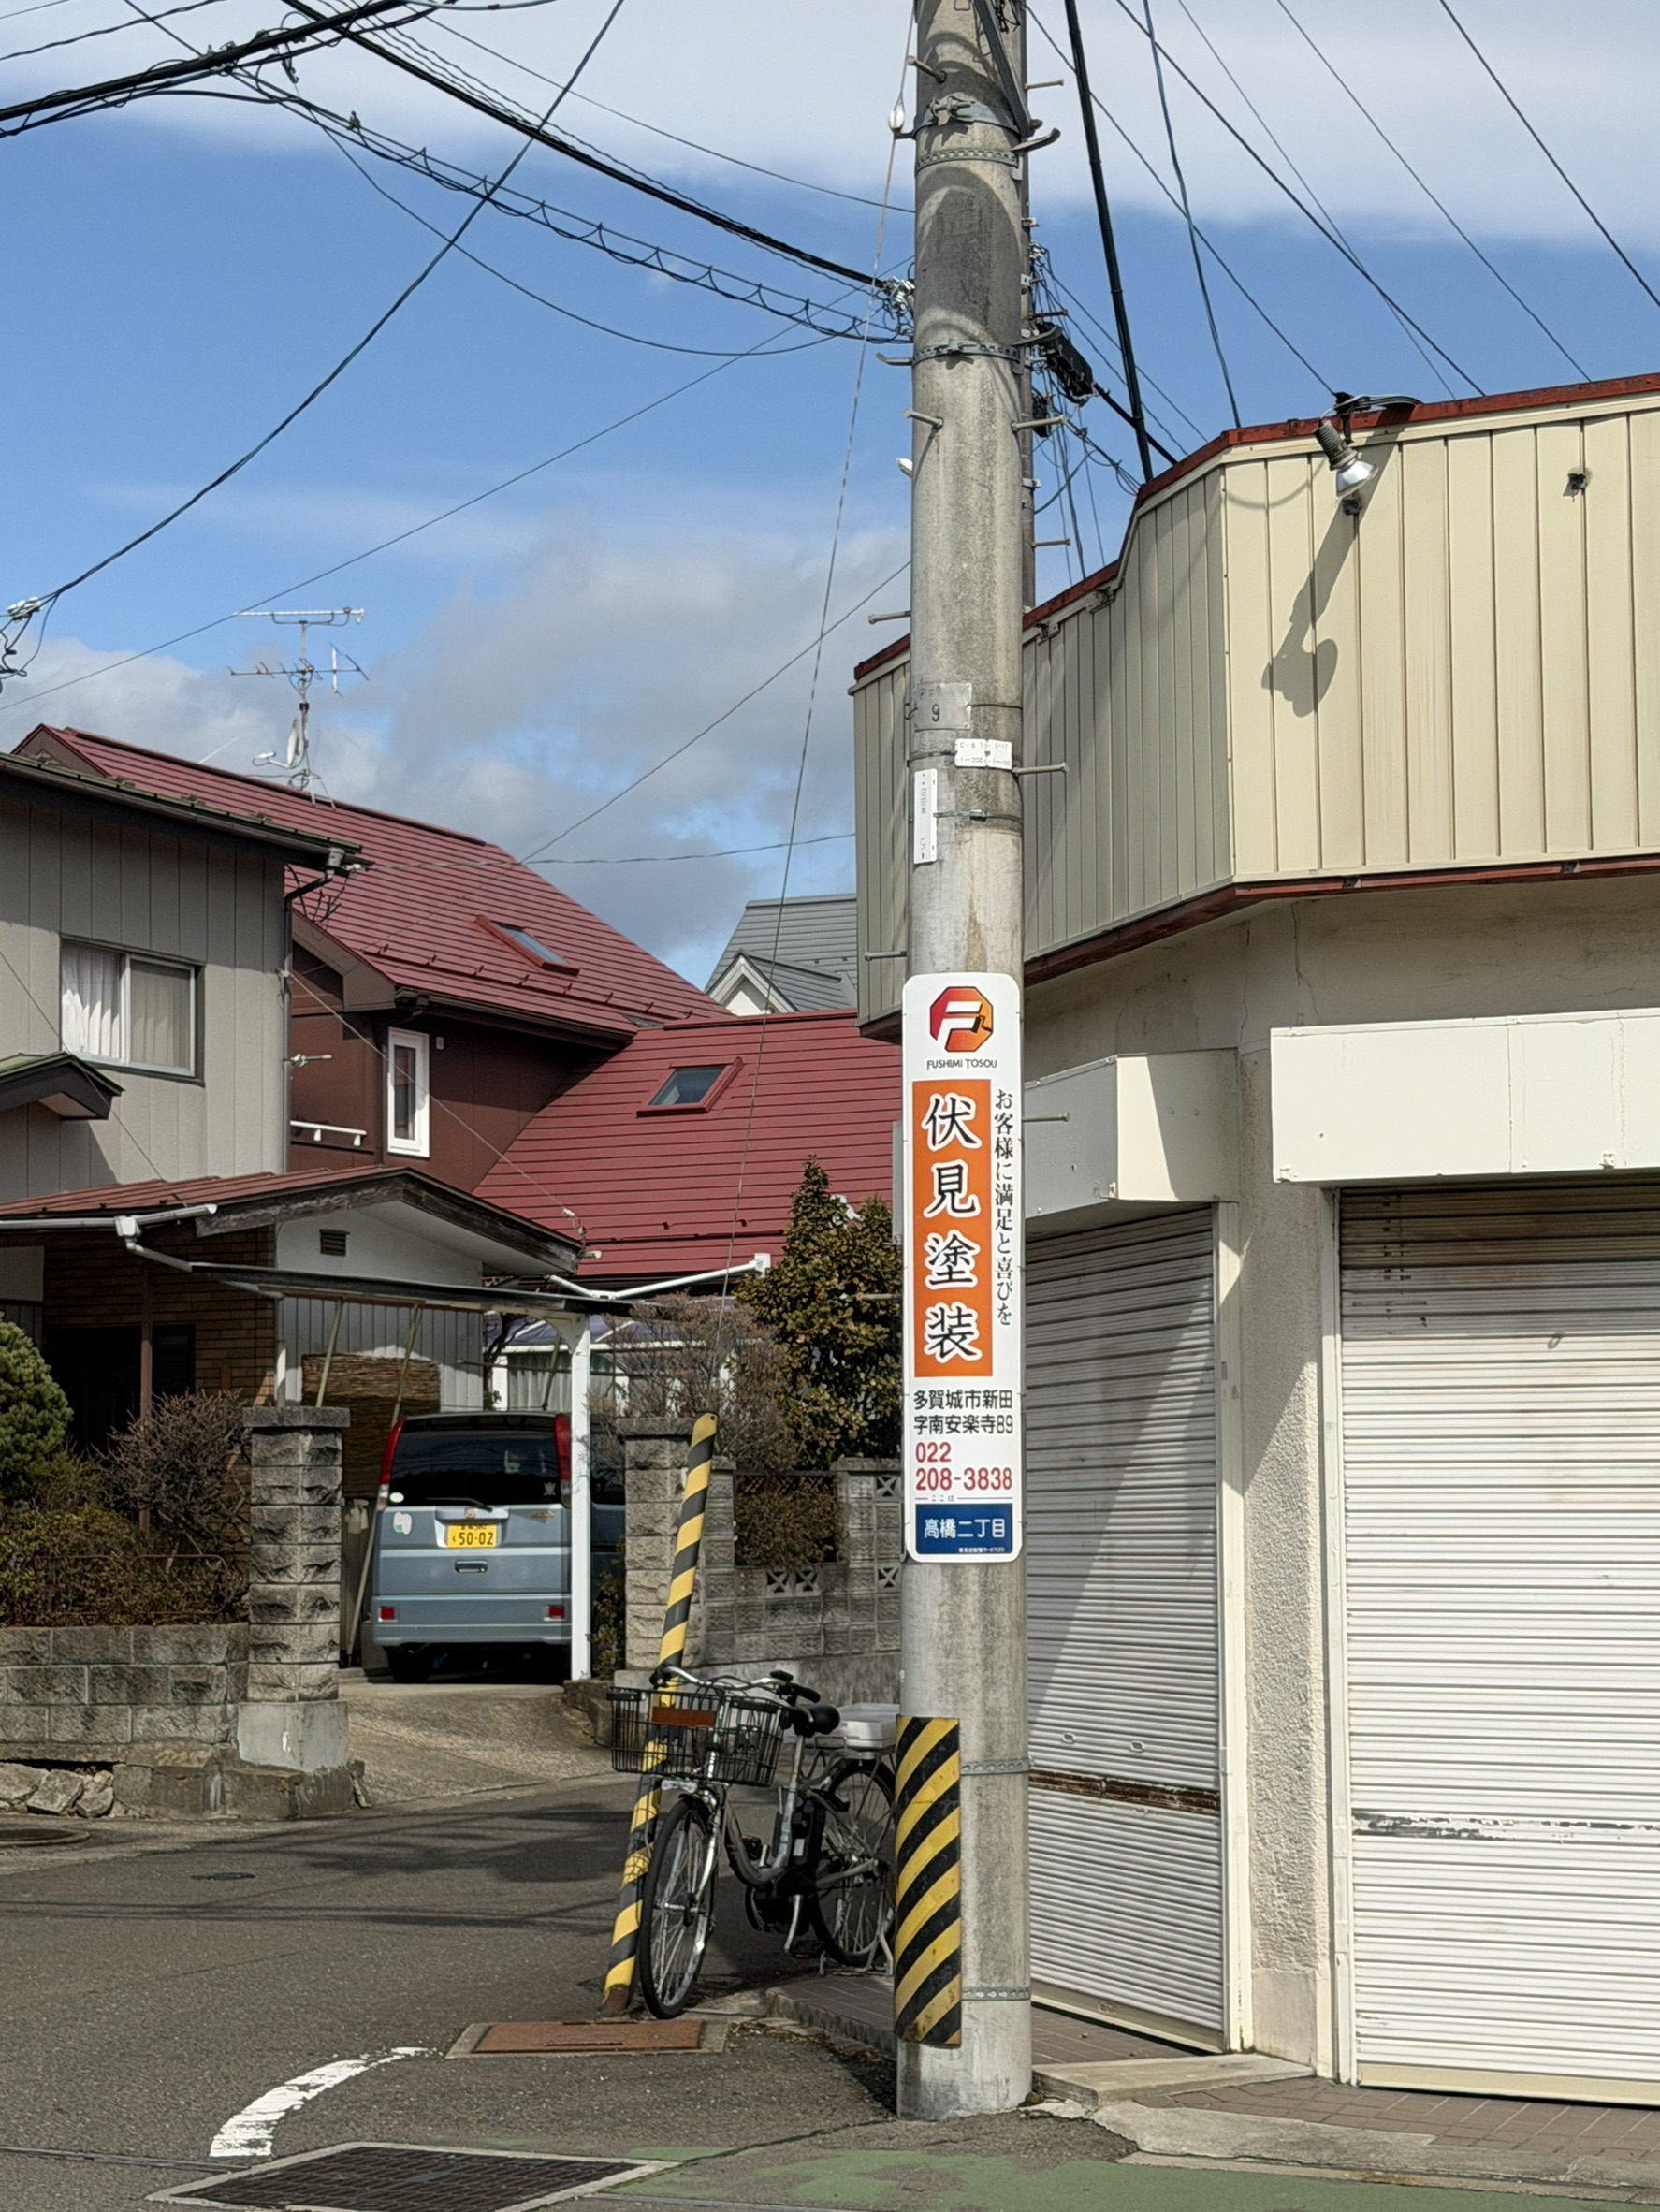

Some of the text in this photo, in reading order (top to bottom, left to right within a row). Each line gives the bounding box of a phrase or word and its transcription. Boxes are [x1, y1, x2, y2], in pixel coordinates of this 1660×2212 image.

[931, 703, 940, 722] 9
[926, 1059, 997, 1070] FUSHIMI TOSOU
[994, 1088, 1014, 1327] お客様に満足と喜びを
[924, 1096, 981, 1361] 伏見塗装
[913, 1389, 1013, 1410] 多賀城市新田
[913, 1414, 1013, 1434] 字南安楽寺89
[915, 1441, 952, 1463] 022
[915, 1466, 1012, 1491] 208-3838
[459, 1532, 494, 1545] 50-02
[924, 1518, 1005, 1539] 高橋二丁目
